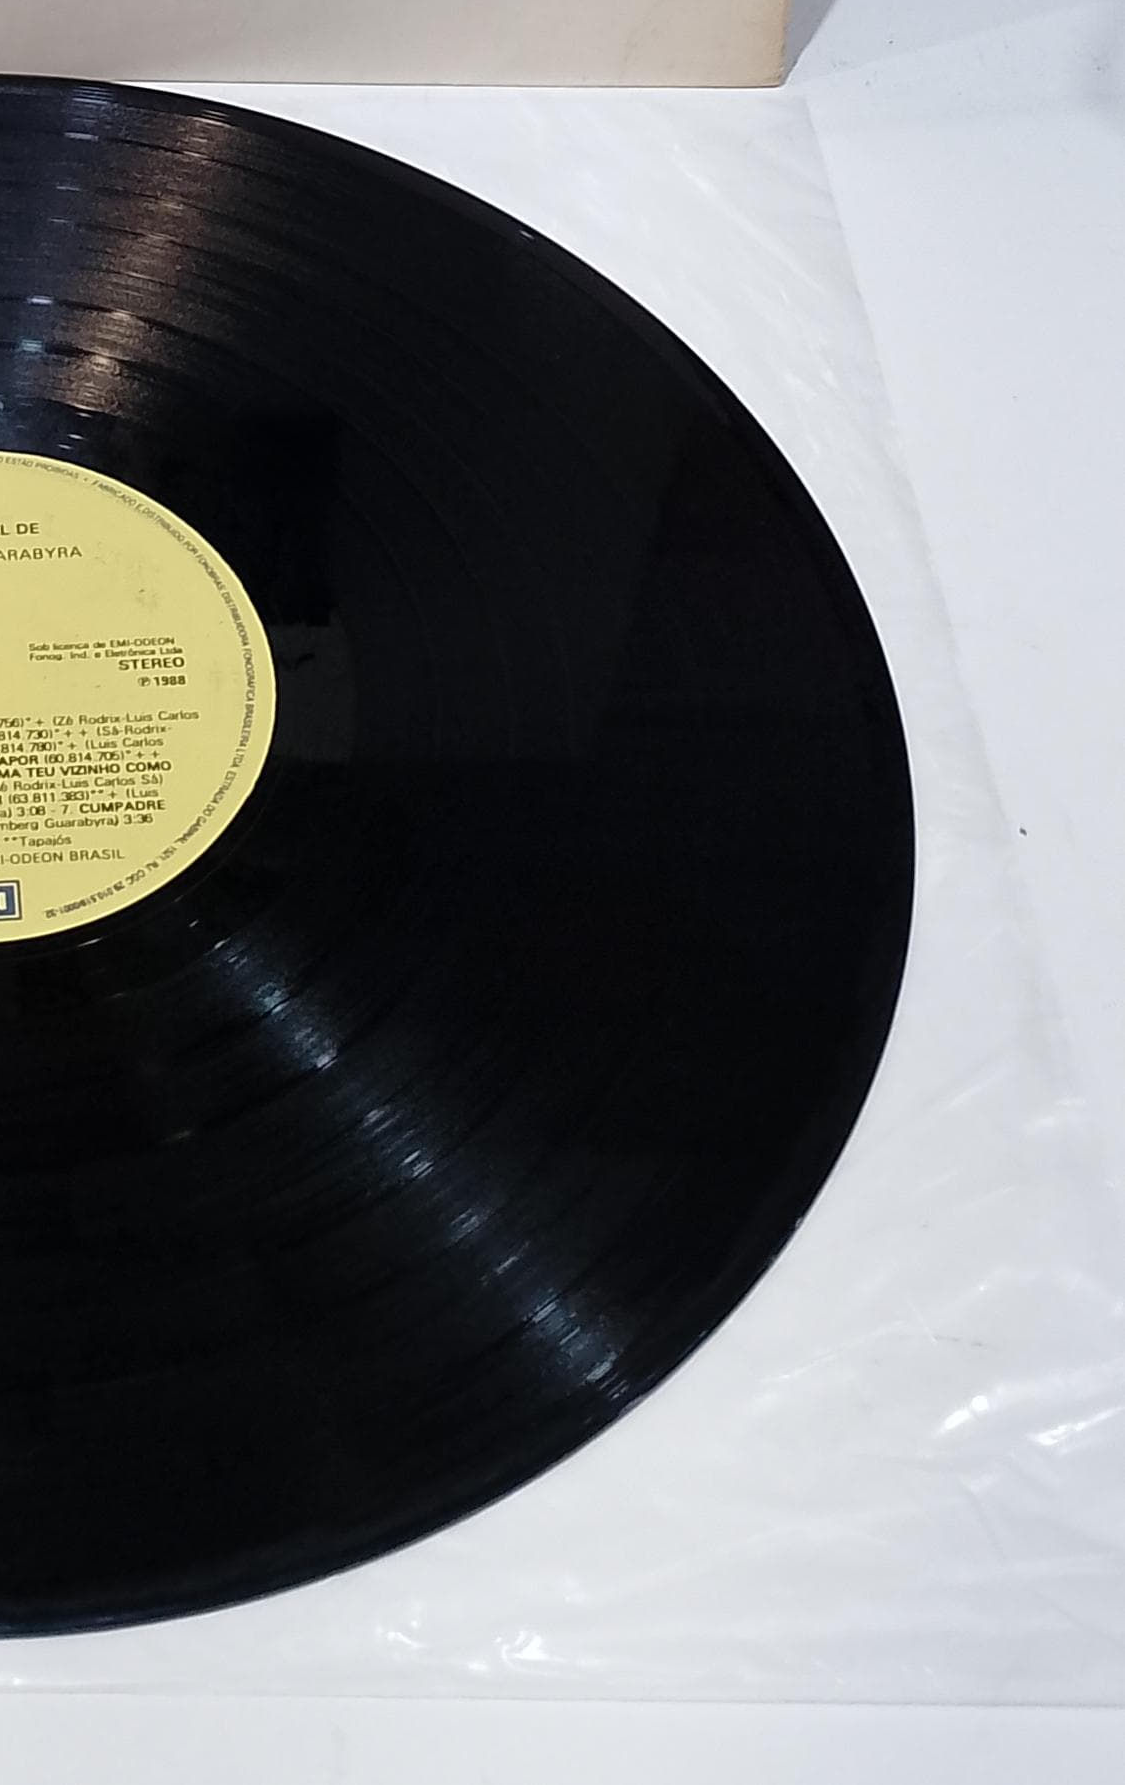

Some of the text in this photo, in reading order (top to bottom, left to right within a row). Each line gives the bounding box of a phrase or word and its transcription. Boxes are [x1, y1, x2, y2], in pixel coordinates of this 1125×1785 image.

[16, 523, 39, 534] DE
[119, 657, 184, 670] STEREO
[153, 675, 186, 686] 1988
[158, 710, 199, 720] Carlos
[122, 737, 164, 748] Carlos
[25, 767, 55, 778] TEU
[60, 764, 120, 776] VIZINHO
[126, 761, 171, 772] COMO
[94, 777, 135, 788] Carlos
[79, 800, 165, 814] CUMPADRE
[203, 804, 217, 816] DO
[44, 815, 119, 828] Guarabyra)
[70, 849, 125, 861] BRASIL
